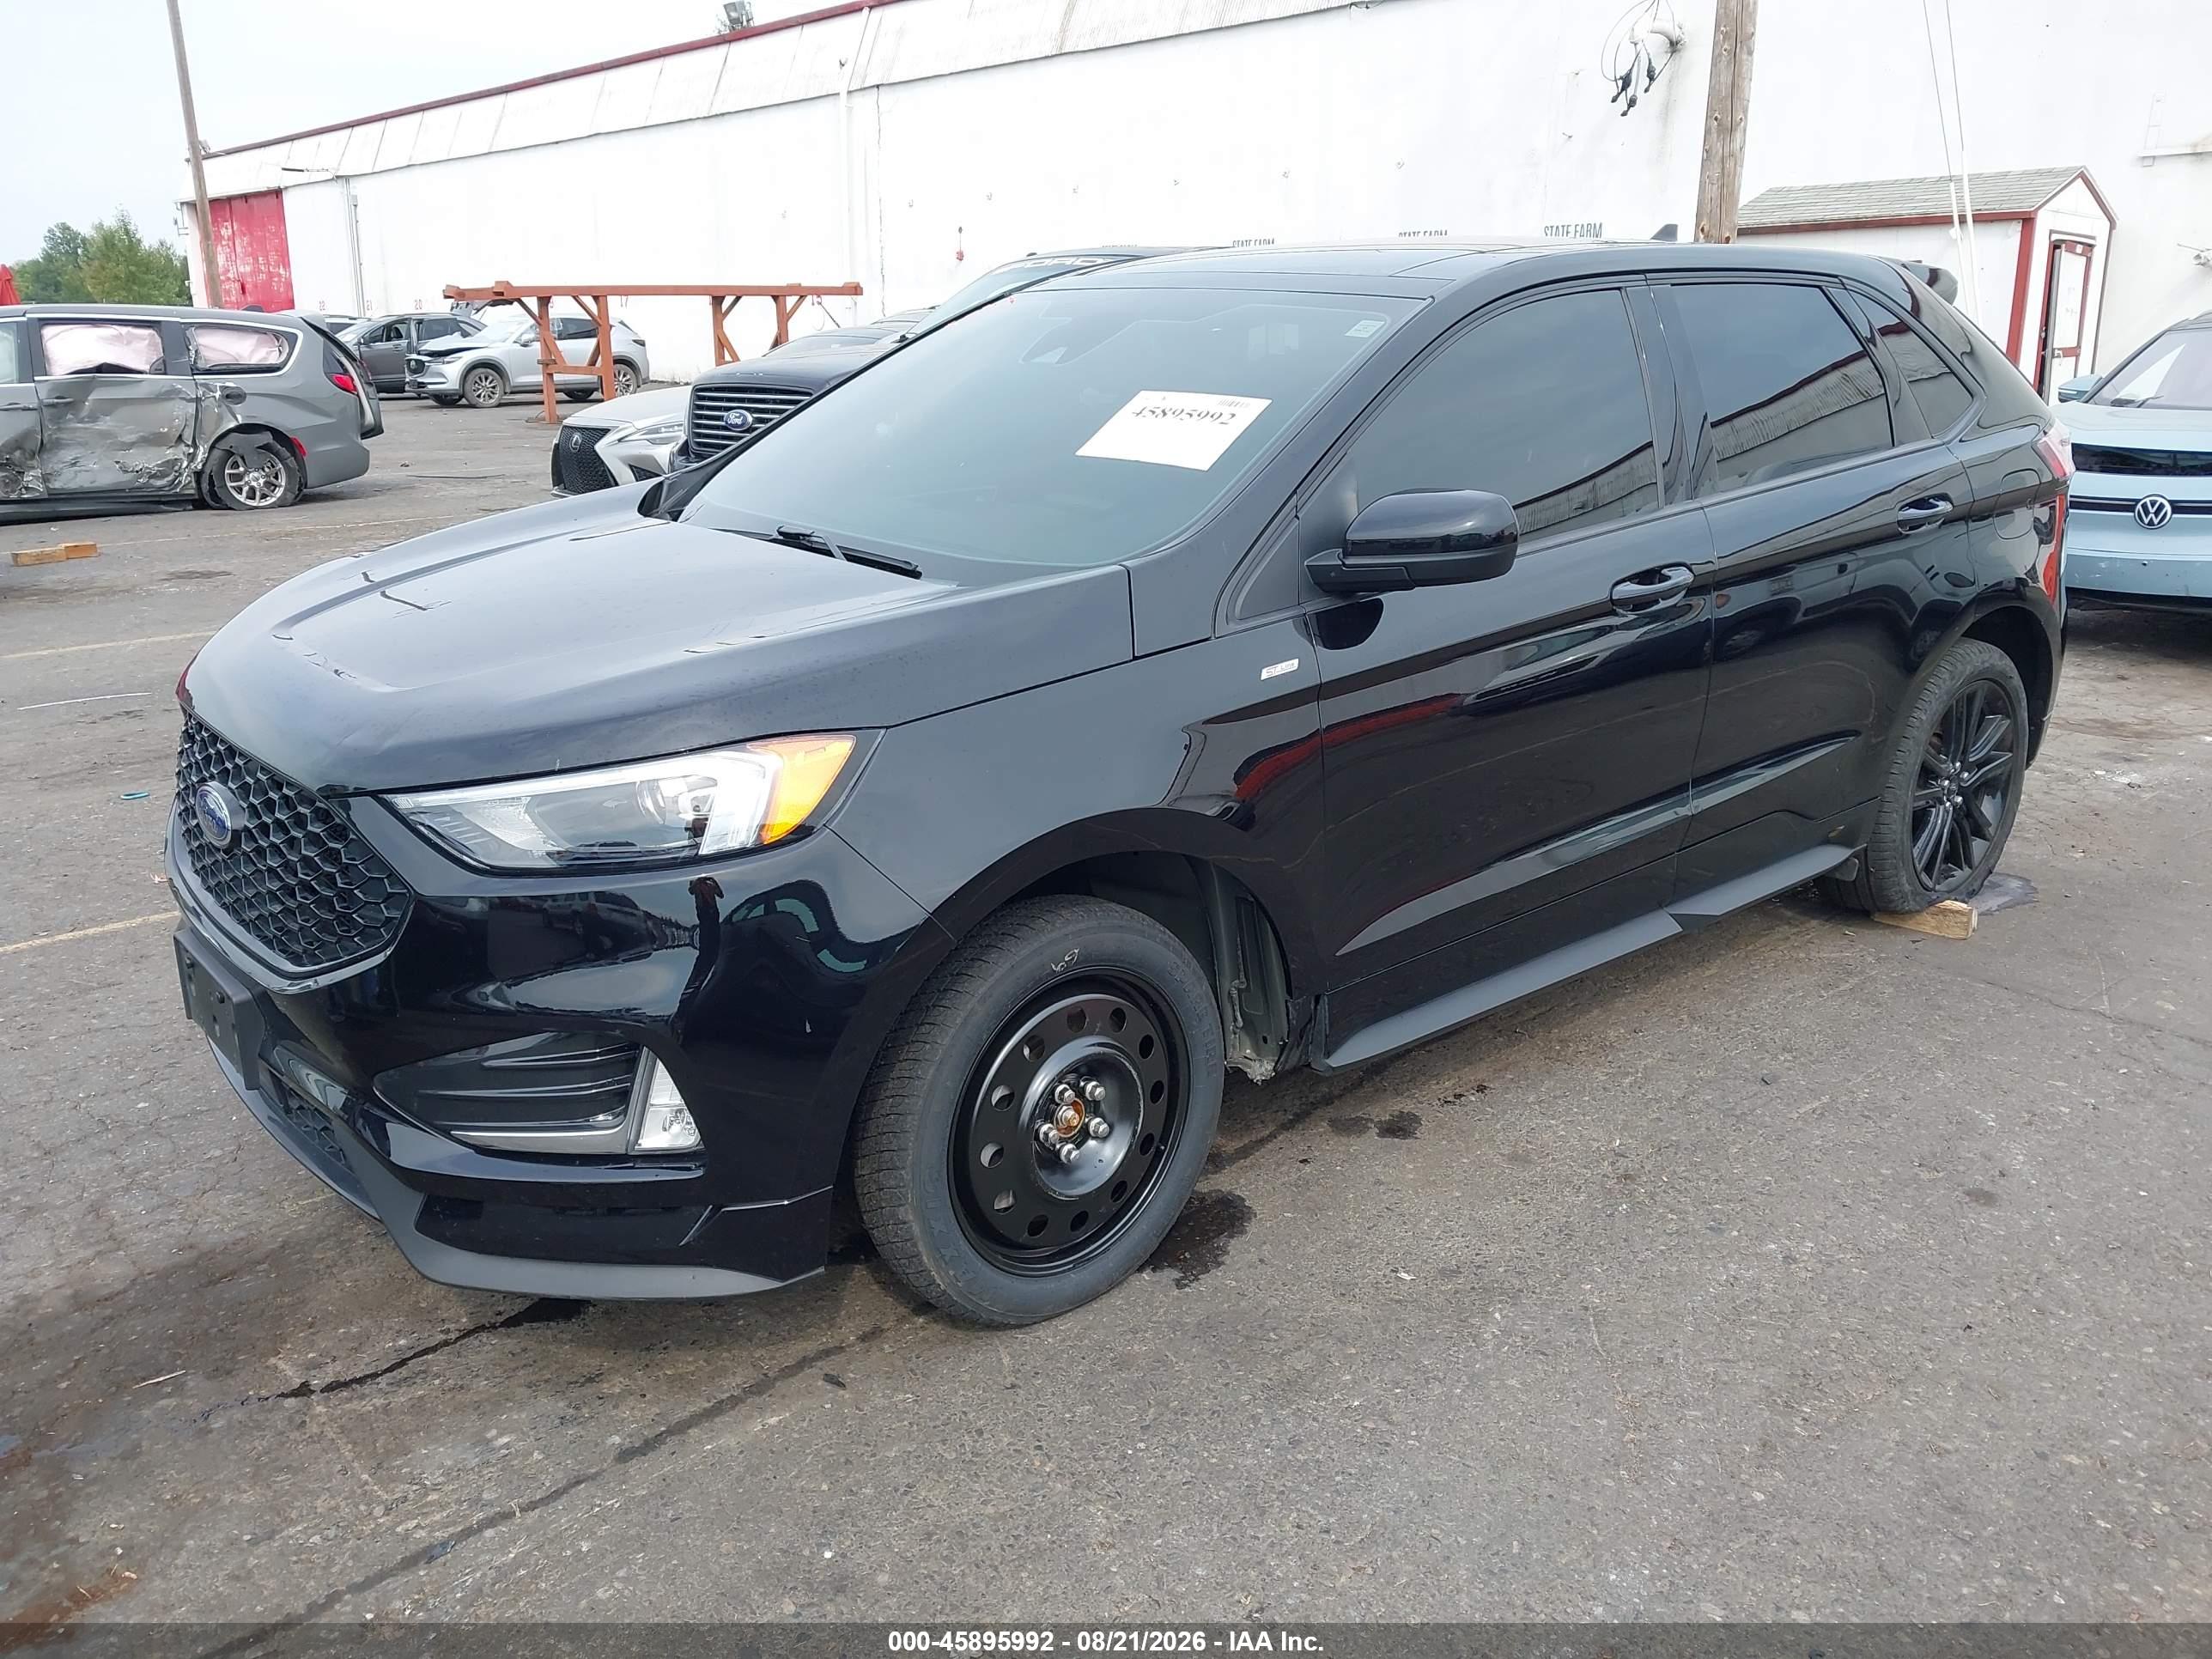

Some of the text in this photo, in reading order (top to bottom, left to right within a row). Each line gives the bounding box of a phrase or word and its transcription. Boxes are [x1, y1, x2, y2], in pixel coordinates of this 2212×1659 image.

[1573, 222, 1602, 239] FARM
[727, 412, 744, 425] Ford
[1132, 405, 1237, 425] 45895992
